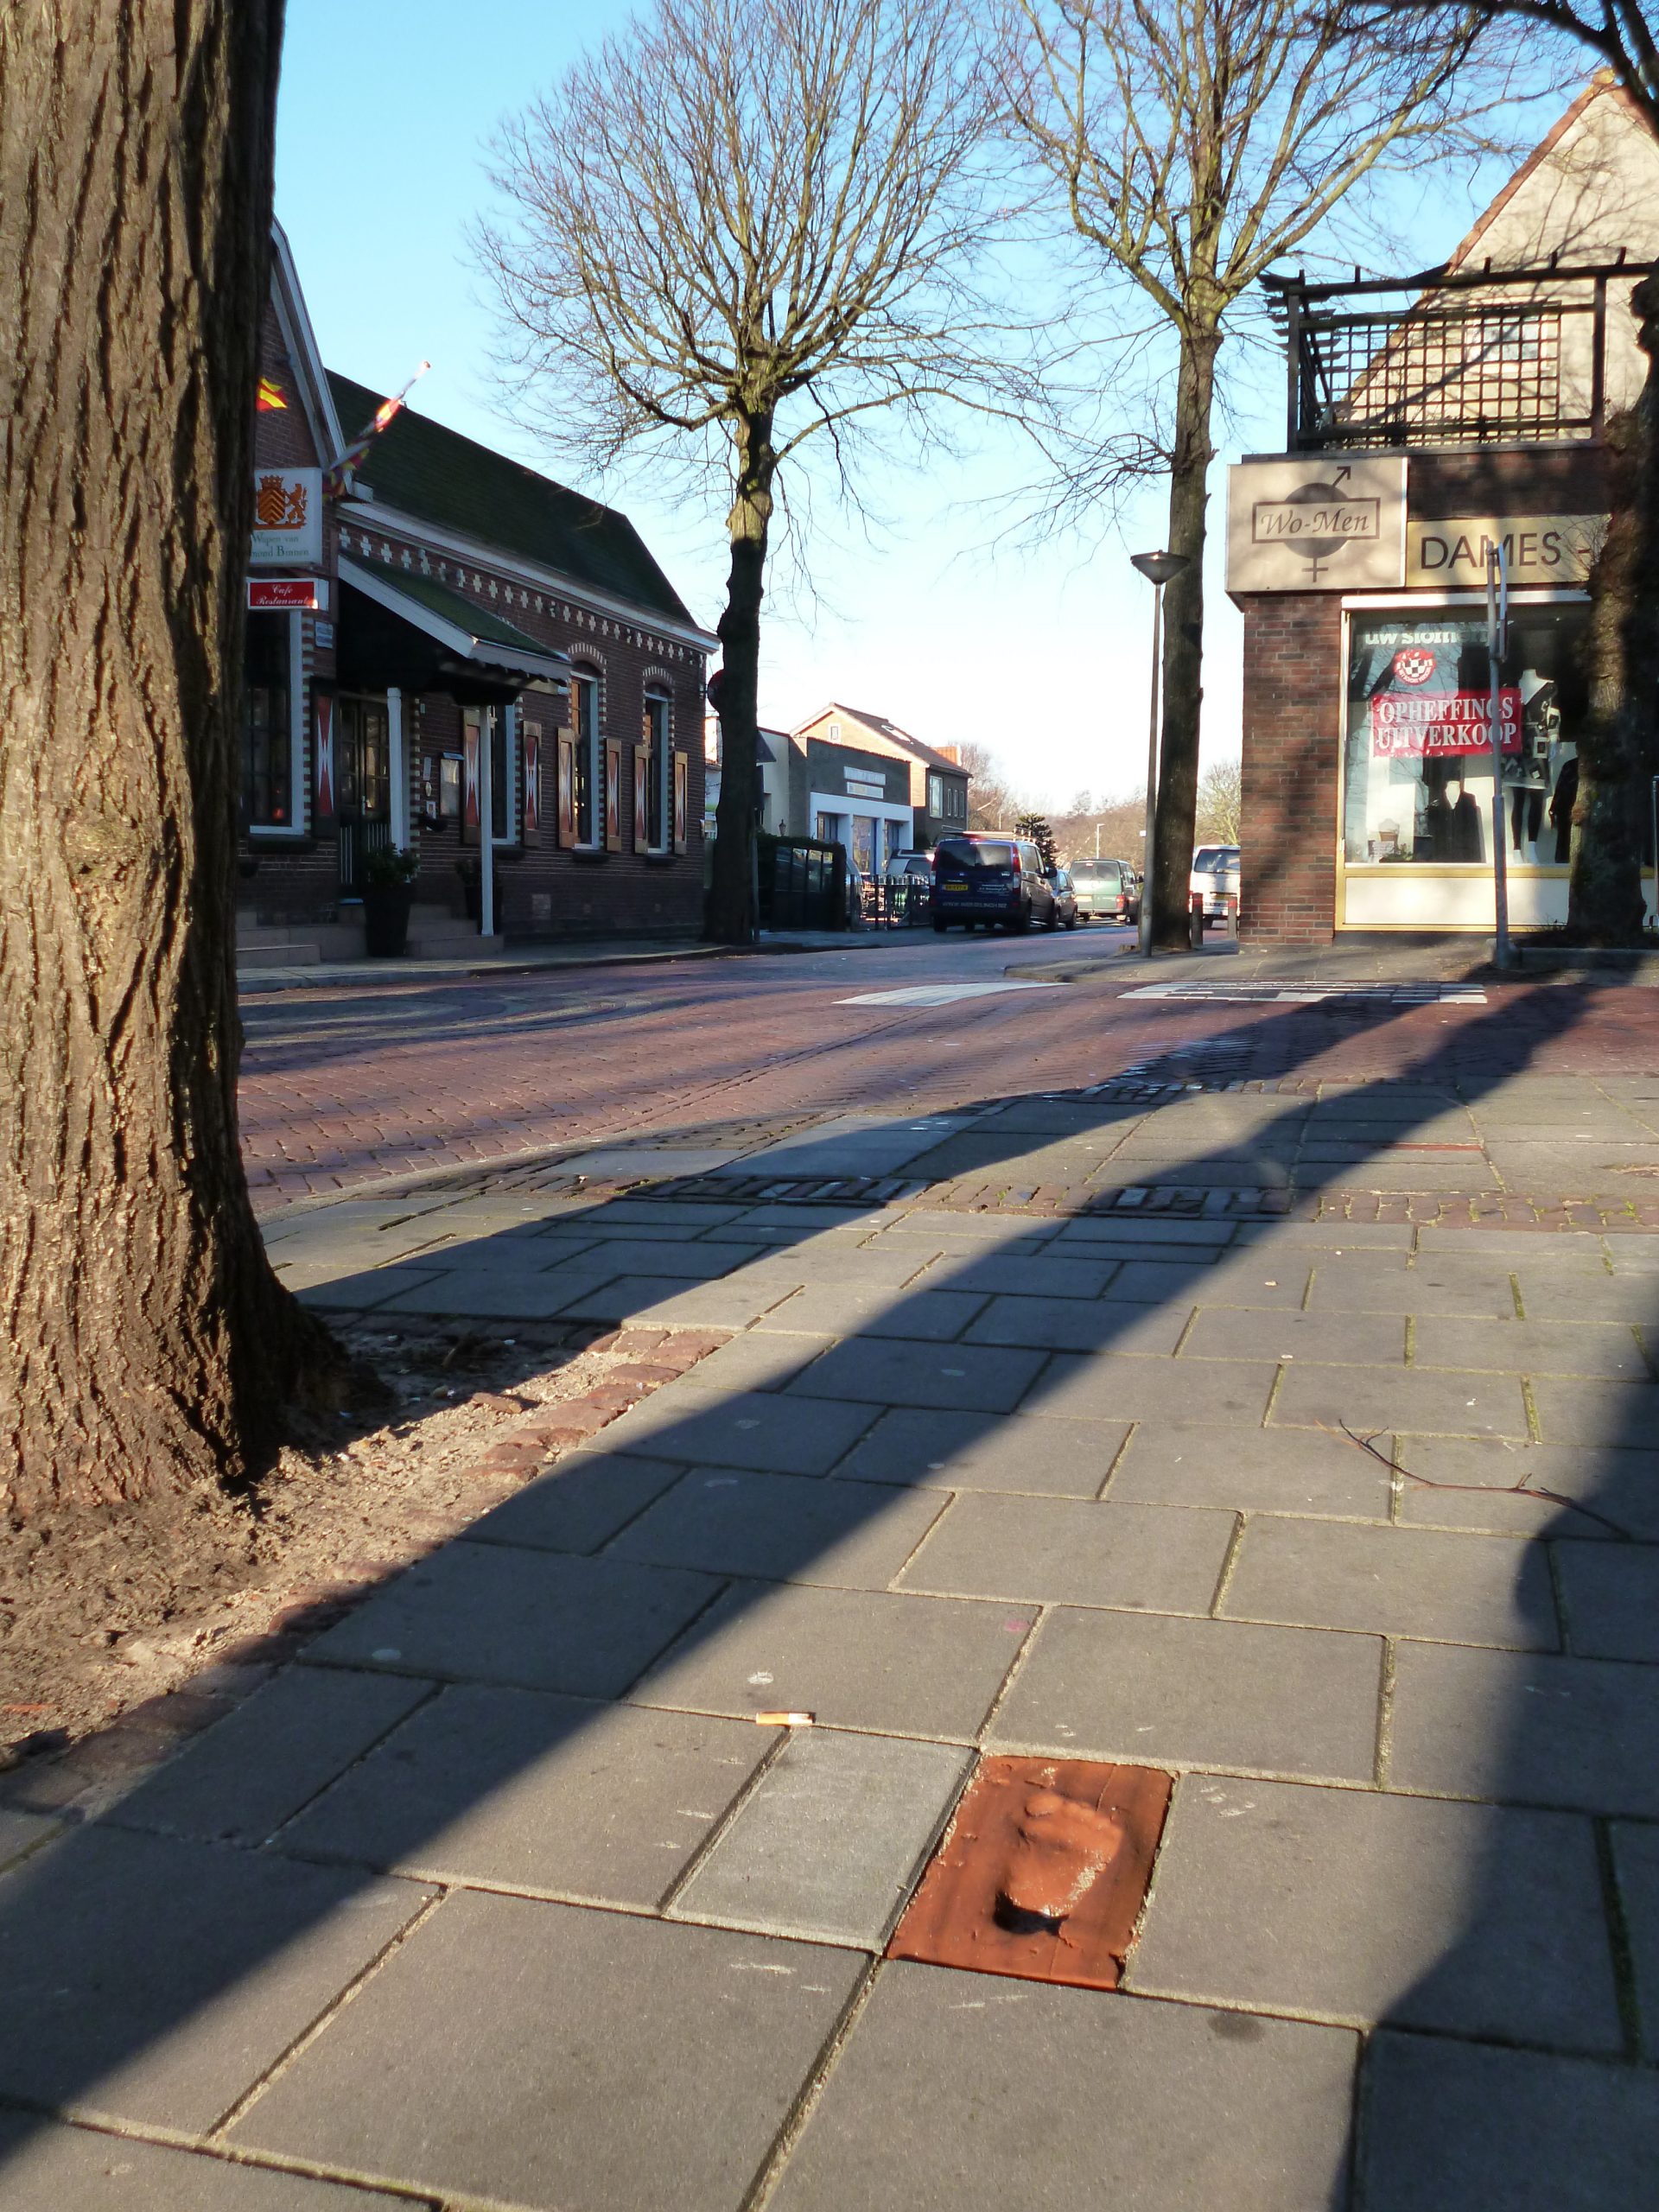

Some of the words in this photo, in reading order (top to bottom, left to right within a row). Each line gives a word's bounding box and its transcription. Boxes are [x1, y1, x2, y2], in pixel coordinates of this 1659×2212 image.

[1261, 507, 1369, 535] Wo-Men
[251, 546, 273, 557] mond
[1421, 531, 1561, 569] DAMES
[1376, 722, 1516, 749] UITVERKOOP
